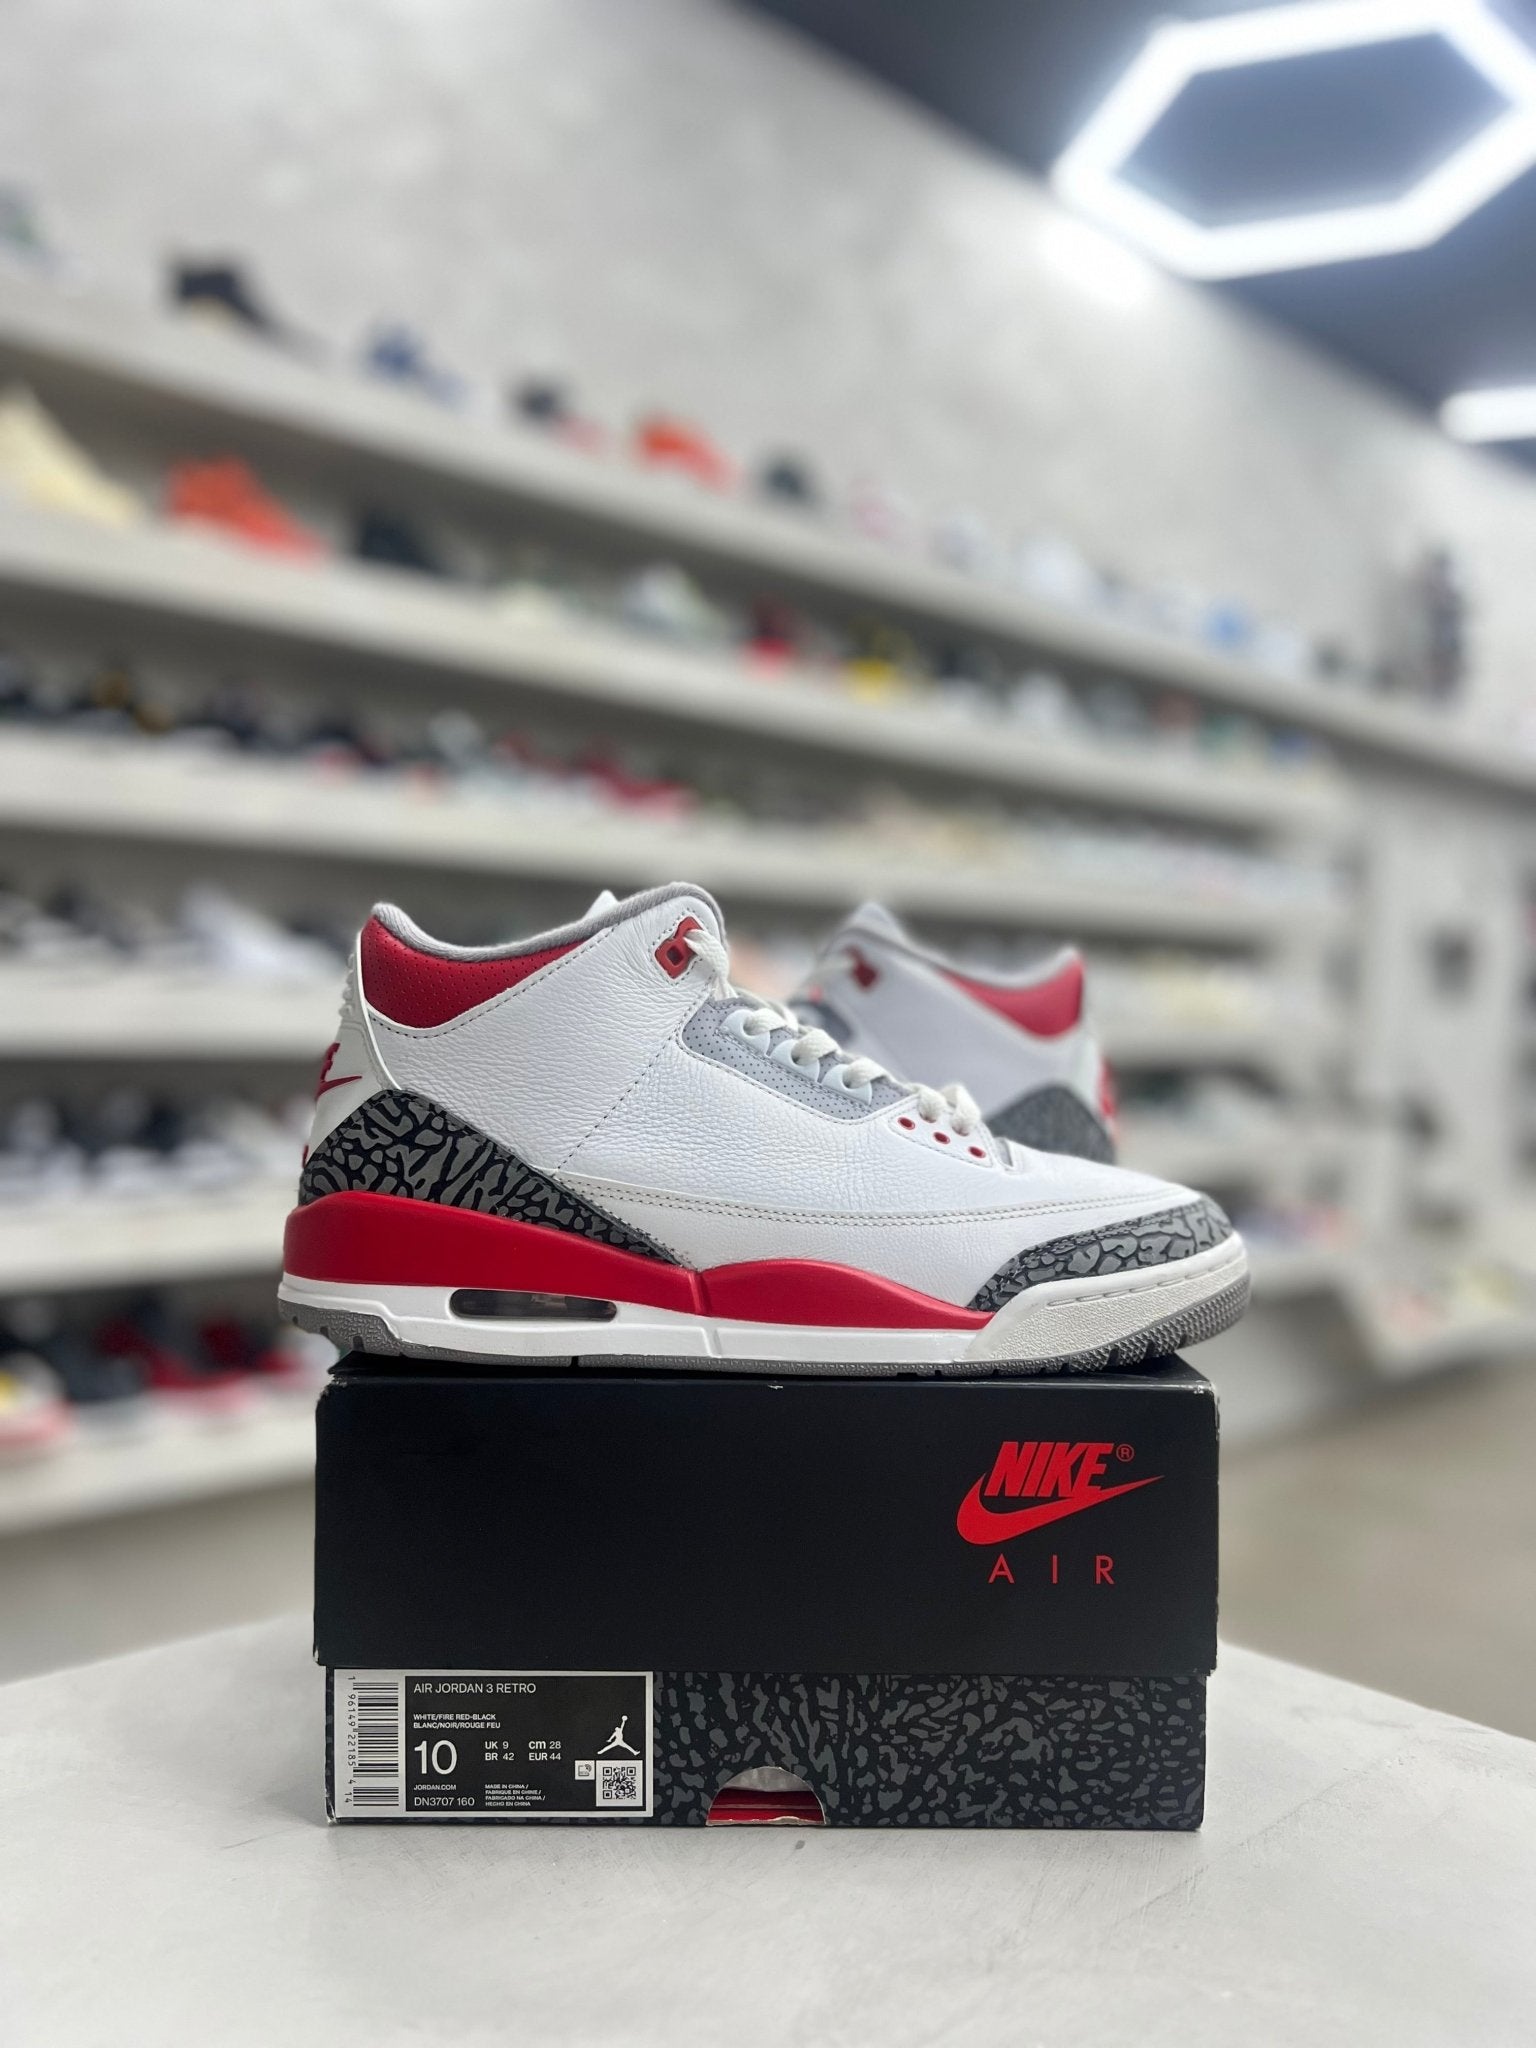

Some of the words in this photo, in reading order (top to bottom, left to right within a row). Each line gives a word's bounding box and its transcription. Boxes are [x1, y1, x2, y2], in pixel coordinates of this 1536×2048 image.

[984, 1441, 1114, 1497] NIKE
[988, 1553, 1115, 1584] AIR
[414, 1683, 432, 1693] AIR
[435, 1683, 483, 1693] JORDAN
[486, 1683, 494, 1693] 3
[496, 1683, 536, 1693] RETRO
[485, 1741, 498, 1749] UK
[503, 1741, 509, 1749] 9
[528, 1741, 546, 1750] cm
[550, 1741, 562, 1749] 28
[414, 1740, 458, 1774] 10
[485, 1752, 498, 1760] BR
[503, 1752, 514, 1760] 42
[528, 1752, 548, 1760] EUR
[550, 1752, 562, 1760] 44
[414, 1797, 454, 1806] DN3707
[456, 1797, 474, 1806] 160
